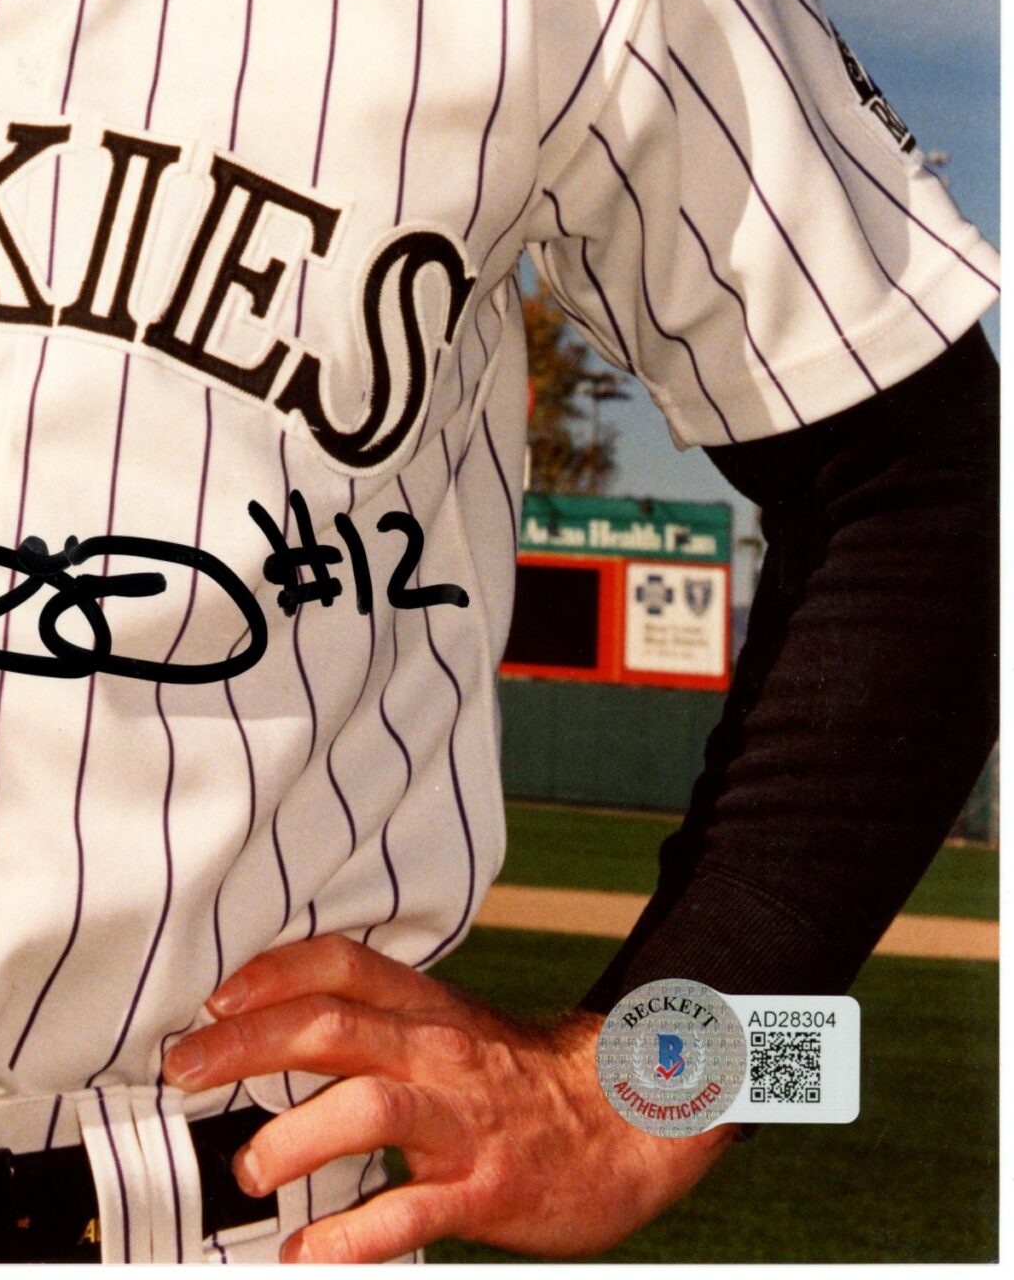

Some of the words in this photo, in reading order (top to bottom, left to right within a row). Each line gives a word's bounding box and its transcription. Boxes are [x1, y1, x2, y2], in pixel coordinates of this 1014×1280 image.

[247, 489, 470, 617] #12
[622, 996, 719, 1029] BECKETT
[748, 1011, 836, 1028] AD28304
[614, 1081, 723, 1121] AUTHENTICATED
